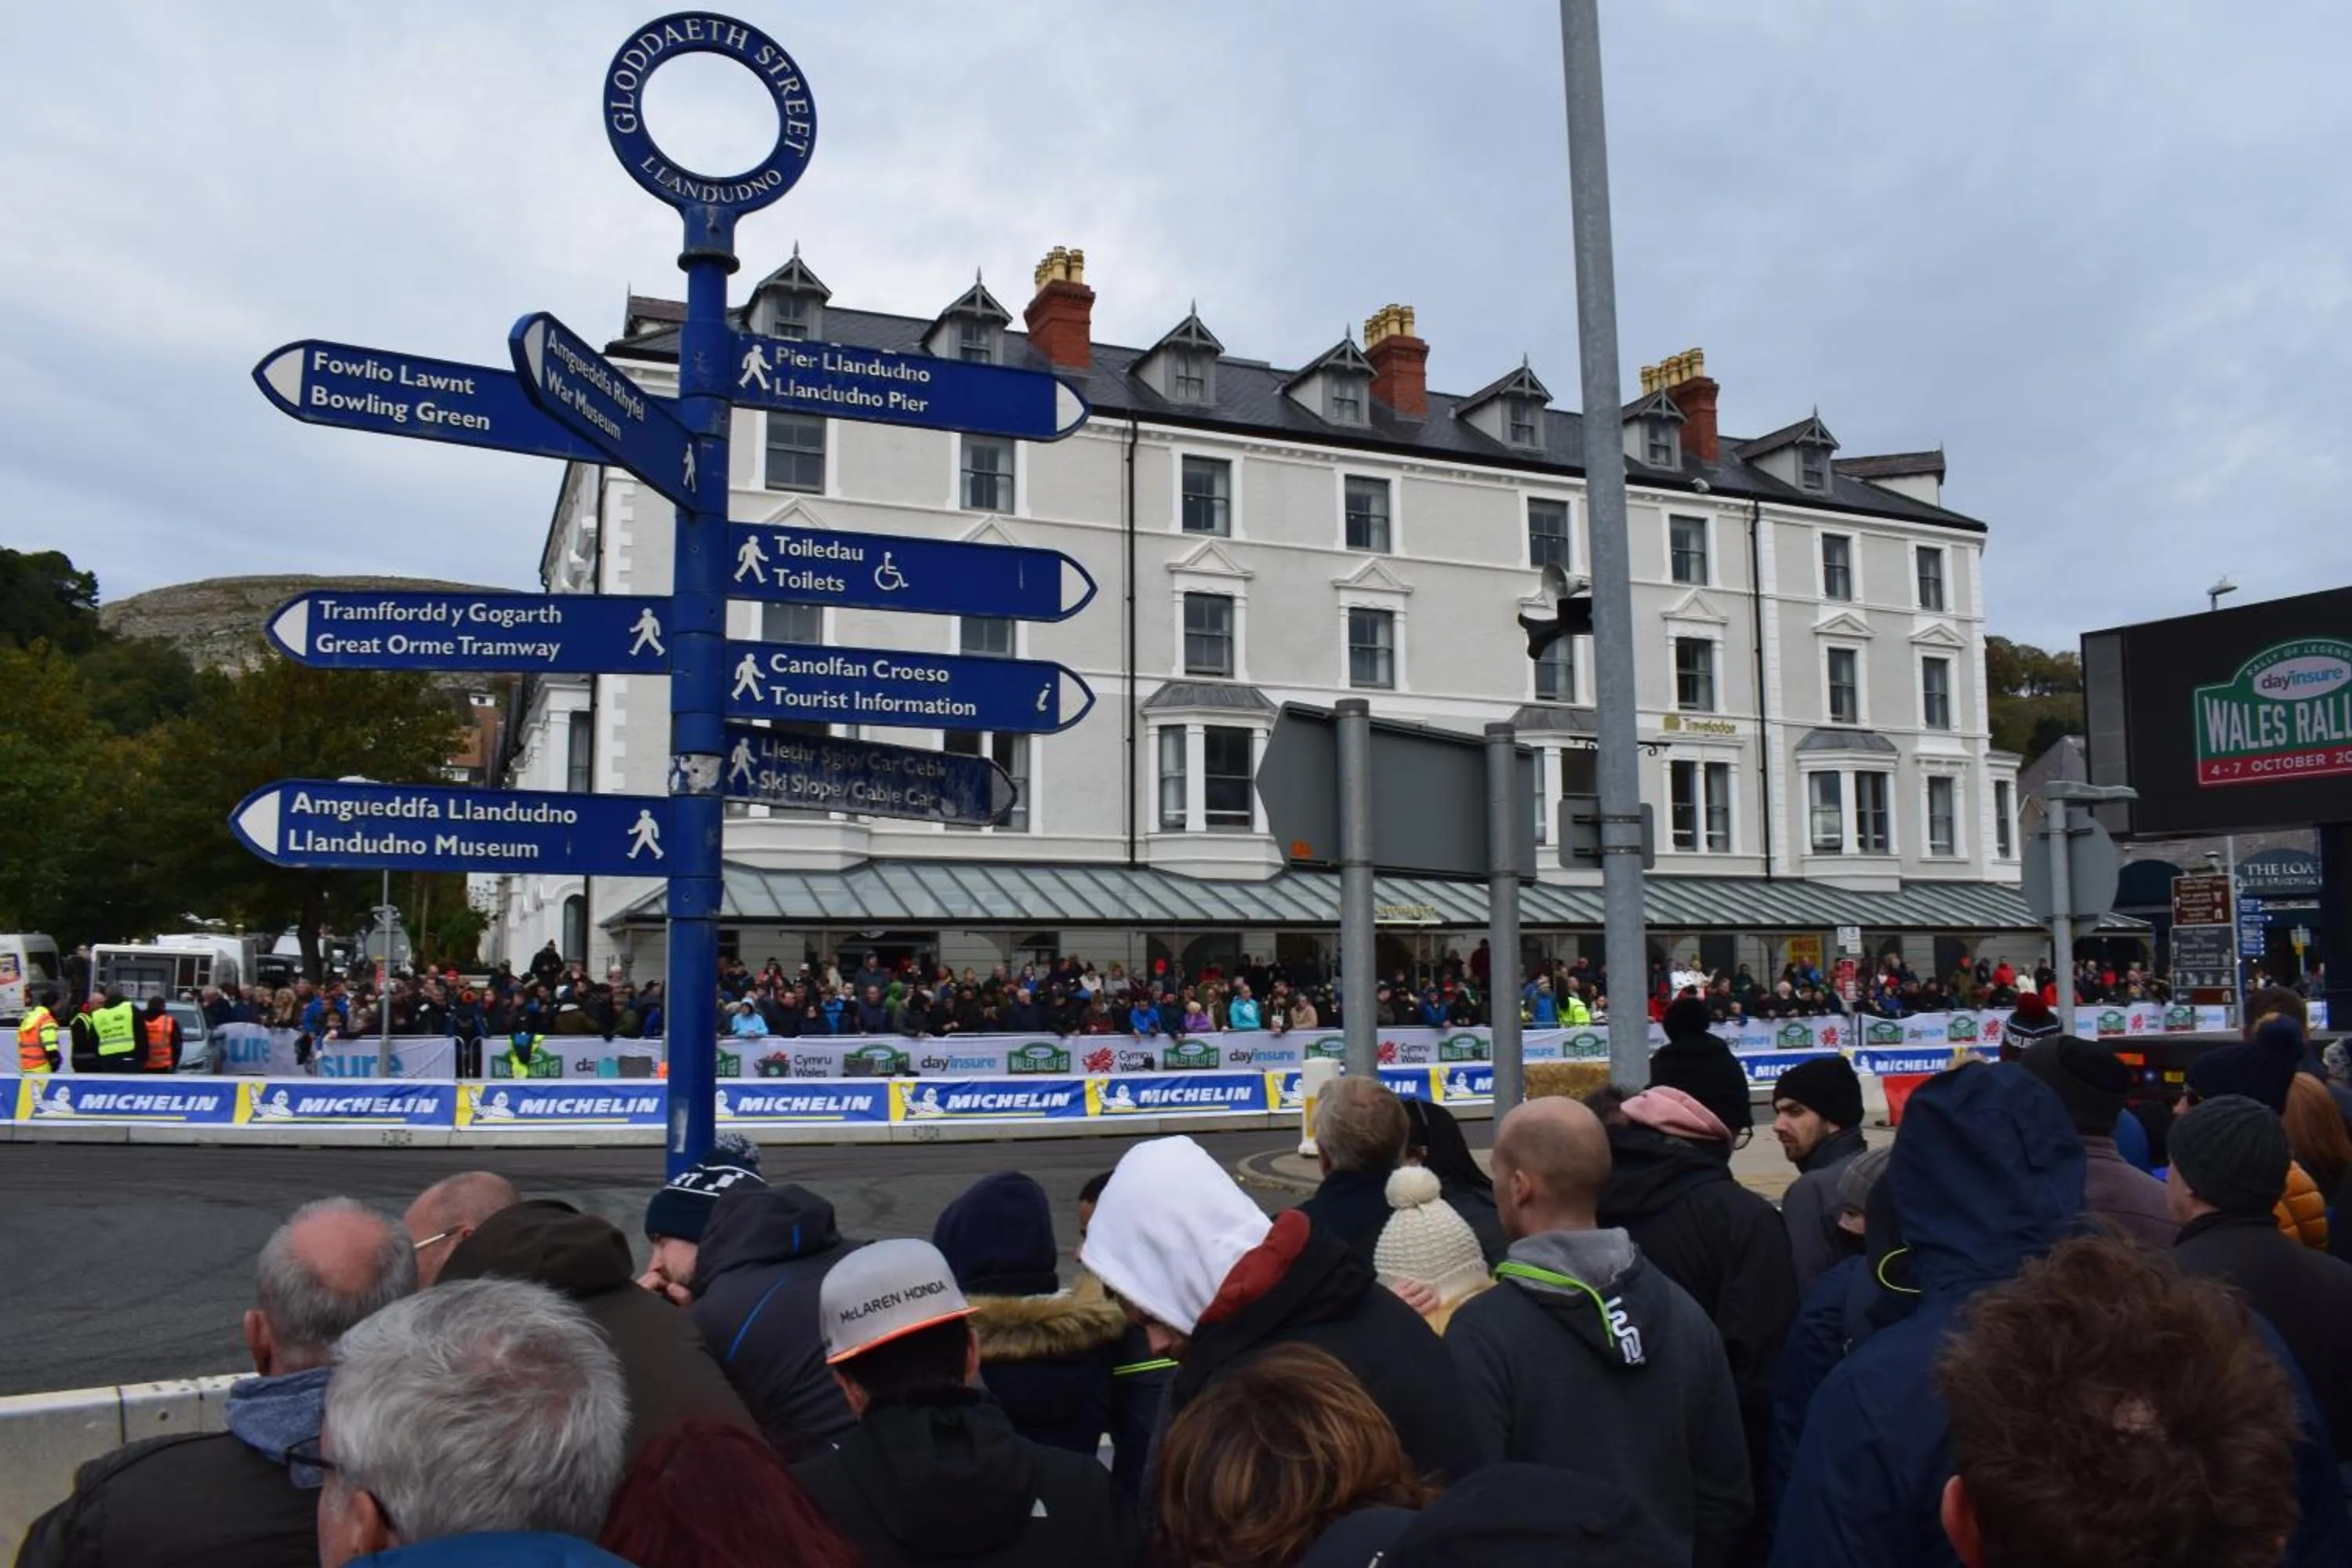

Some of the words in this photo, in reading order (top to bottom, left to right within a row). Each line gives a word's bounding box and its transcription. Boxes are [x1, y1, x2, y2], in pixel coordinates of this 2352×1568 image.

[610, 18, 750, 134] GLODDAETH
[754, 44, 811, 158] STREET
[640, 156, 782, 203] LLANDUDNO
[314, 351, 393, 382] Fowlio
[400, 365, 475, 394] Lawnt
[546, 329, 613, 393] Amgueddfa
[613, 379, 644, 422] Rhyfel
[775, 347, 818, 367] Pier
[822, 353, 931, 383] Llandudno
[310, 385, 408, 423] Bowling
[416, 402, 490, 430] Green
[546, 368, 574, 401] War
[575, 389, 622, 441] Museum
[775, 378, 884, 408] Llandudno
[888, 391, 928, 412] Pier
[774, 535, 864, 561] Toiledau
[773, 568, 846, 593] Toilets
[318, 601, 448, 622] Tramffordd
[451, 608, 463, 627] y
[469, 604, 563, 628] Gogarth
[315, 633, 382, 655] Great
[387, 635, 454, 655] Orme
[458, 636, 561, 662] Tramway
[2303, 644, 2352, 661] LEGEND
[770, 653, 866, 678] Canolfan
[873, 660, 950, 683] Croeso
[2261, 667, 2343, 691] dayinsure
[770, 686, 848, 709] Tourist
[855, 689, 977, 717] Information
[2204, 695, 2288, 753] WALES
[2294, 692, 2352, 744] RALL
[2251, 753, 2326, 772] OCTOBER
[2335, 750, 2352, 764] 20
[760, 771, 787, 790] Ski
[904, 787, 938, 807] Car
[290, 791, 441, 822] Amgueddfa
[448, 798, 578, 825] Llandudno
[288, 829, 427, 855] Llandudno
[435, 835, 539, 859] Museum
[2243, 863, 2280, 876] THE
[2282, 862, 2315, 875] LOA
[793, 1054, 833, 1069] Cymru
[920, 1055, 996, 1072] dayinsure
[1229, 1050, 1295, 1064] dayinsure
[1875, 1058, 1948, 1073] MICHELIN
[794, 1066, 829, 1078] Wales
[78, 1093, 220, 1112] MICHELIN
[296, 1096, 439, 1114] MICHELIN
[517, 1096, 660, 1115] MICHELIN
[737, 1094, 873, 1112] MICHELIN
[946, 1091, 1071, 1112] MICHELIN
[1139, 1086, 1253, 1104] MICHELIN
[840, 1293, 902, 1324] McLAREN
[903, 1280, 949, 1302] HONDA
